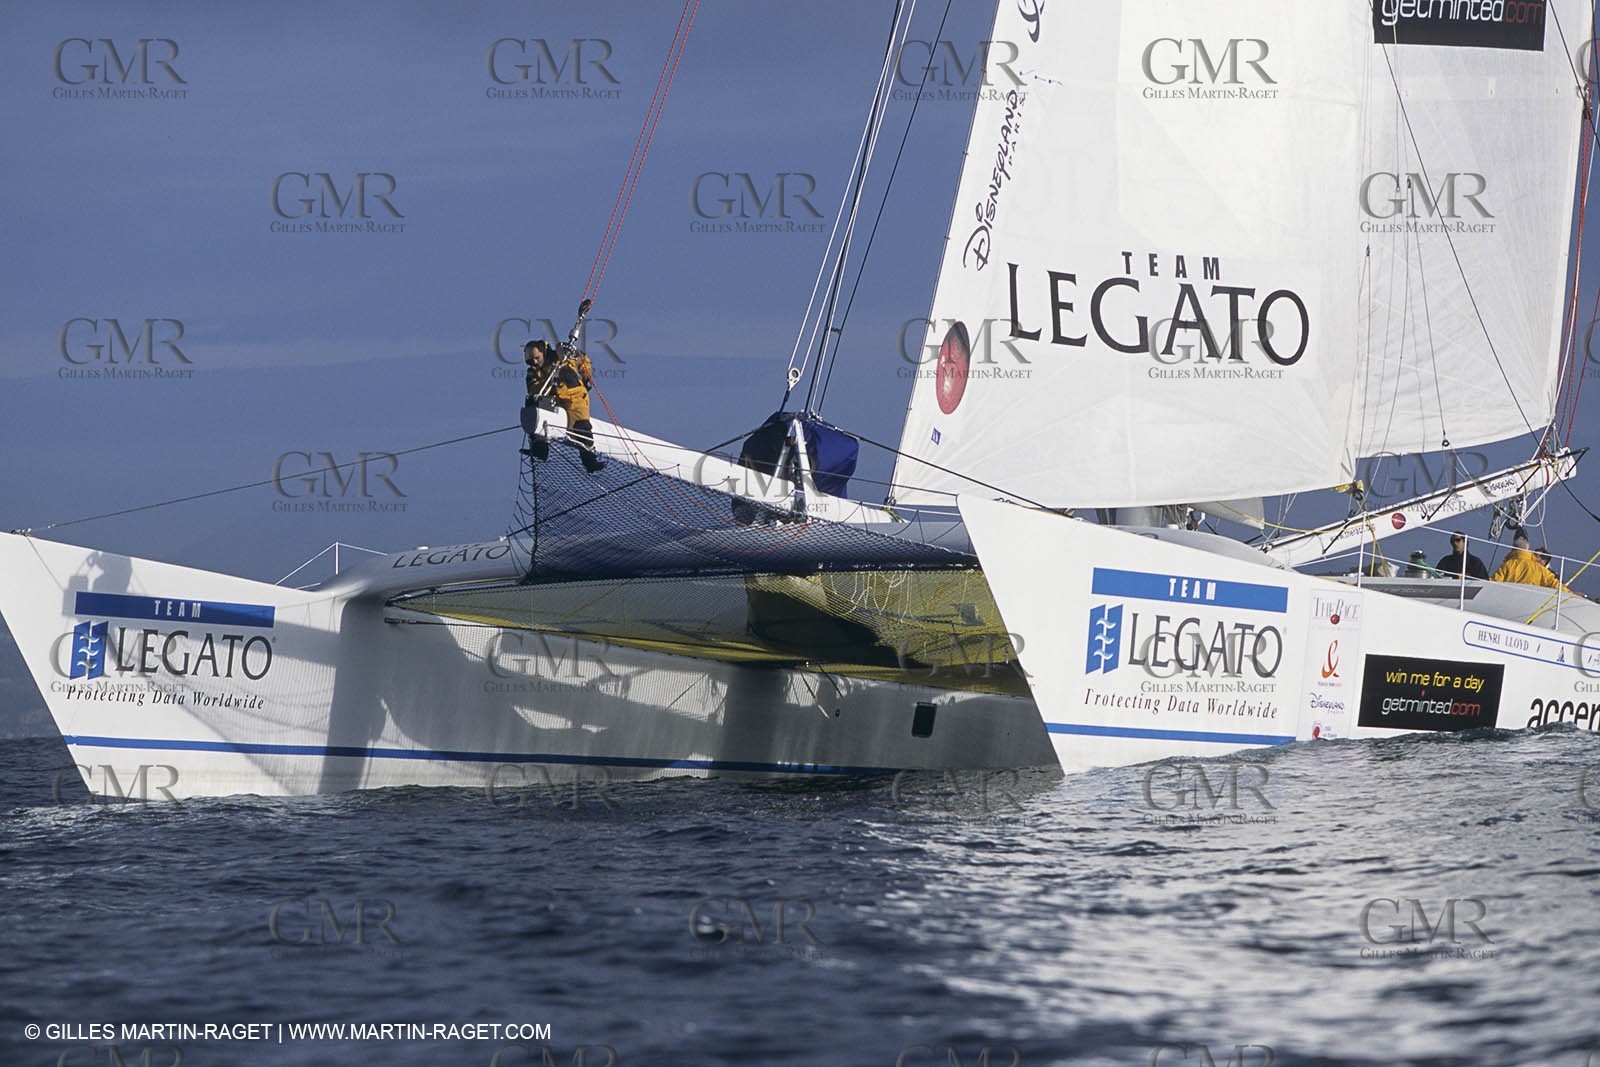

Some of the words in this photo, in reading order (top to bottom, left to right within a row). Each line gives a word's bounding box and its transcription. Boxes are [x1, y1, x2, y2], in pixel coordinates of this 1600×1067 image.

[1122, 251, 1220, 280] TEAM
[1007, 262, 1309, 366] LEGATO
[392, 545, 510, 568] LEGATO
[1169, 578, 1217, 600] TEAM
[154, 600, 201, 618] TEAM
[1128, 613, 1283, 678] LEGATO
[1478, 630, 1501, 645] HENRI
[1505, 636, 1529, 651] LLOYD
[115, 627, 272, 680] LEGATO
[1386, 668, 1407, 684] win
[1409, 673, 1430, 686] me
[1433, 671, 1451, 687] for
[1453, 676, 1461, 688] a
[1464, 674, 1485, 693] day
[67, 685, 145, 706] Protecting
[152, 690, 185, 705] Data
[192, 691, 265, 709] Worldwide
[1168, 695, 1200, 714] Data
[1207, 698, 1278, 719] Worldwide
